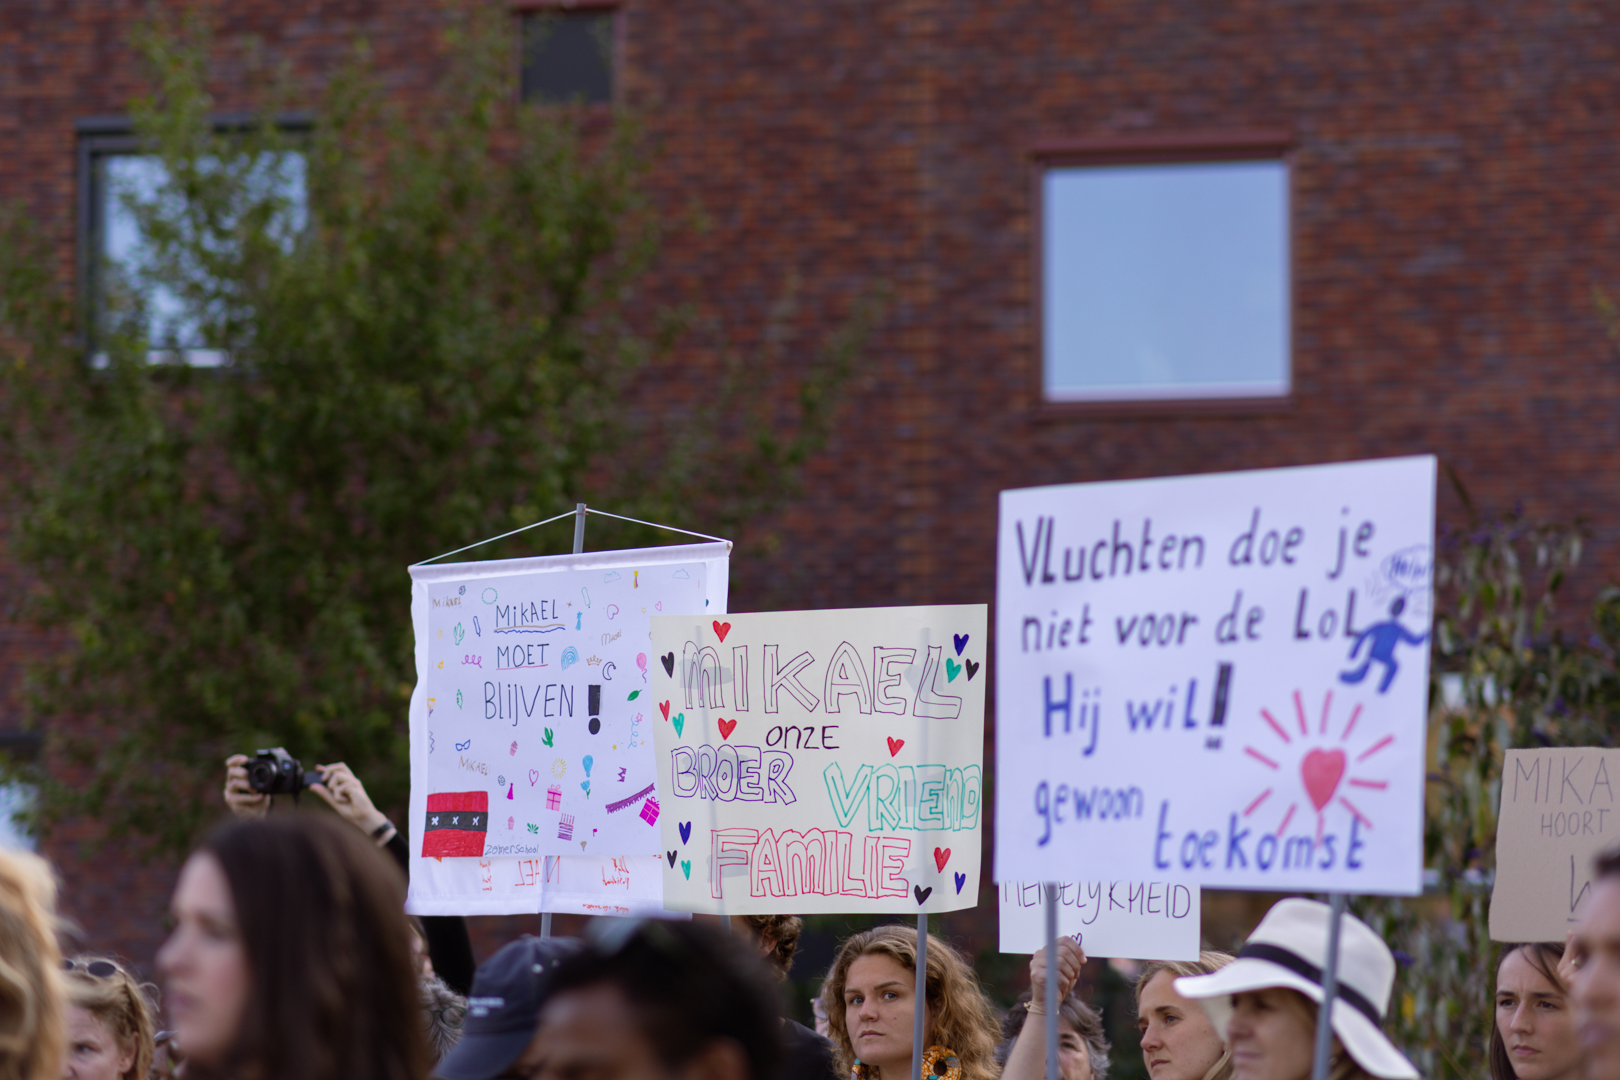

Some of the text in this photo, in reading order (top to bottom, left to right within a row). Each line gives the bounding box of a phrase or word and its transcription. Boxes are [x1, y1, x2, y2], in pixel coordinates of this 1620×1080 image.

[1228, 505, 1304, 566] doe
[1326, 505, 1375, 581] je
[1021, 602, 1094, 653] niet
[1115, 611, 1200, 648] voor
[1215, 588, 1265, 645] de
[497, 643, 550, 669] MOET
[1043, 671, 1102, 758] Hij
[671, 744, 797, 806] BROER
[1513, 756, 1614, 805] MIKA
[1033, 779, 1145, 848] gewoon
[1153, 800, 1366, 871] toekomst
[1541, 808, 1610, 838] HOORT
